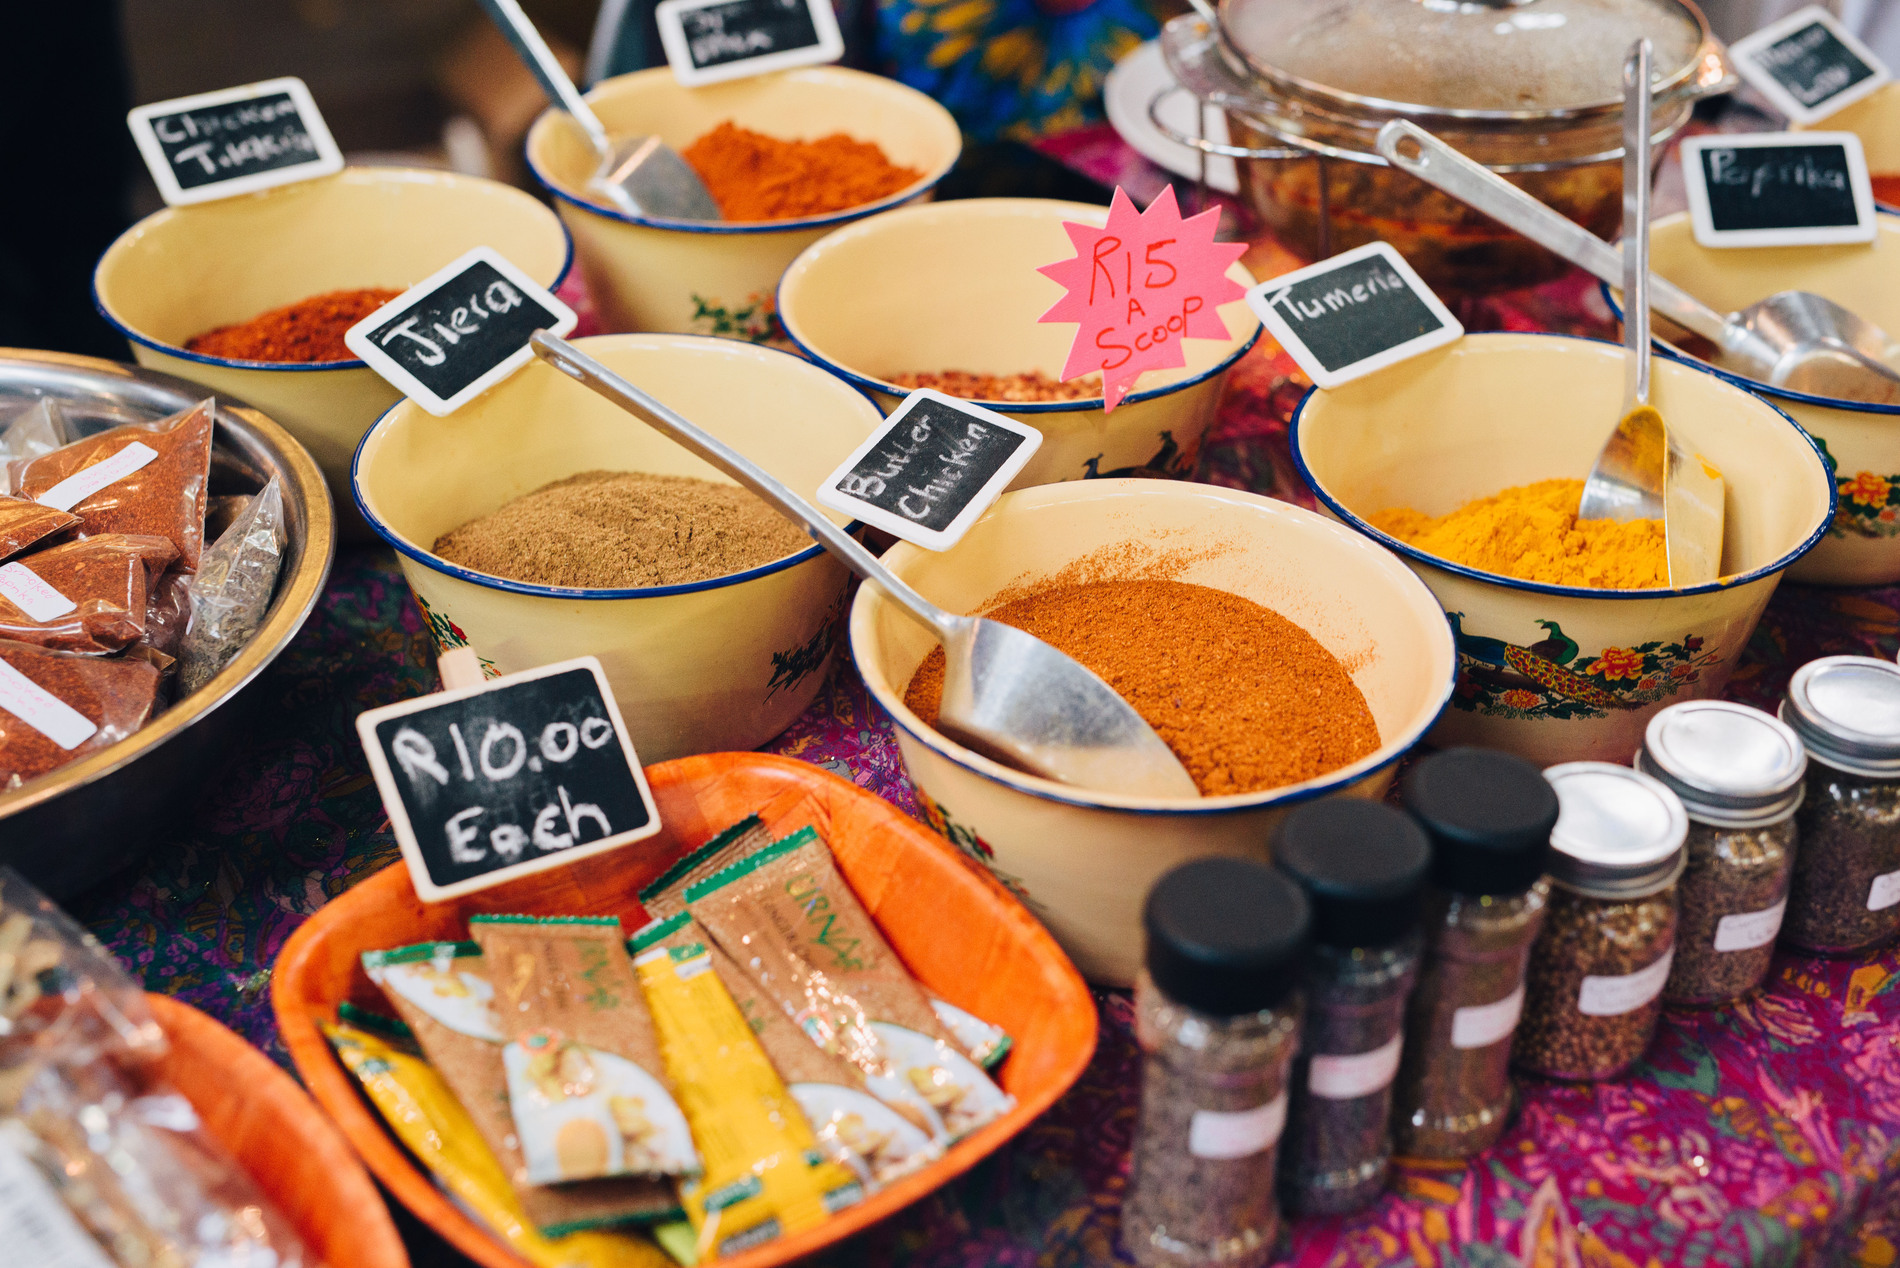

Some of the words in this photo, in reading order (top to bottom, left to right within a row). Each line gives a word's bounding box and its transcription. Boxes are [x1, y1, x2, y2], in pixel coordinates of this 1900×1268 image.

[1709, 149, 1846, 198] Paprika
[1089, 236, 1177, 306] R15
[381, 280, 523, 367] Jiera
[1127, 298, 1146, 325] A
[837, 414, 932, 498] Butter
[898, 421, 990, 519] Chicken
[391, 716, 614, 786] R10.00
[444, 785, 612, 863] Each
